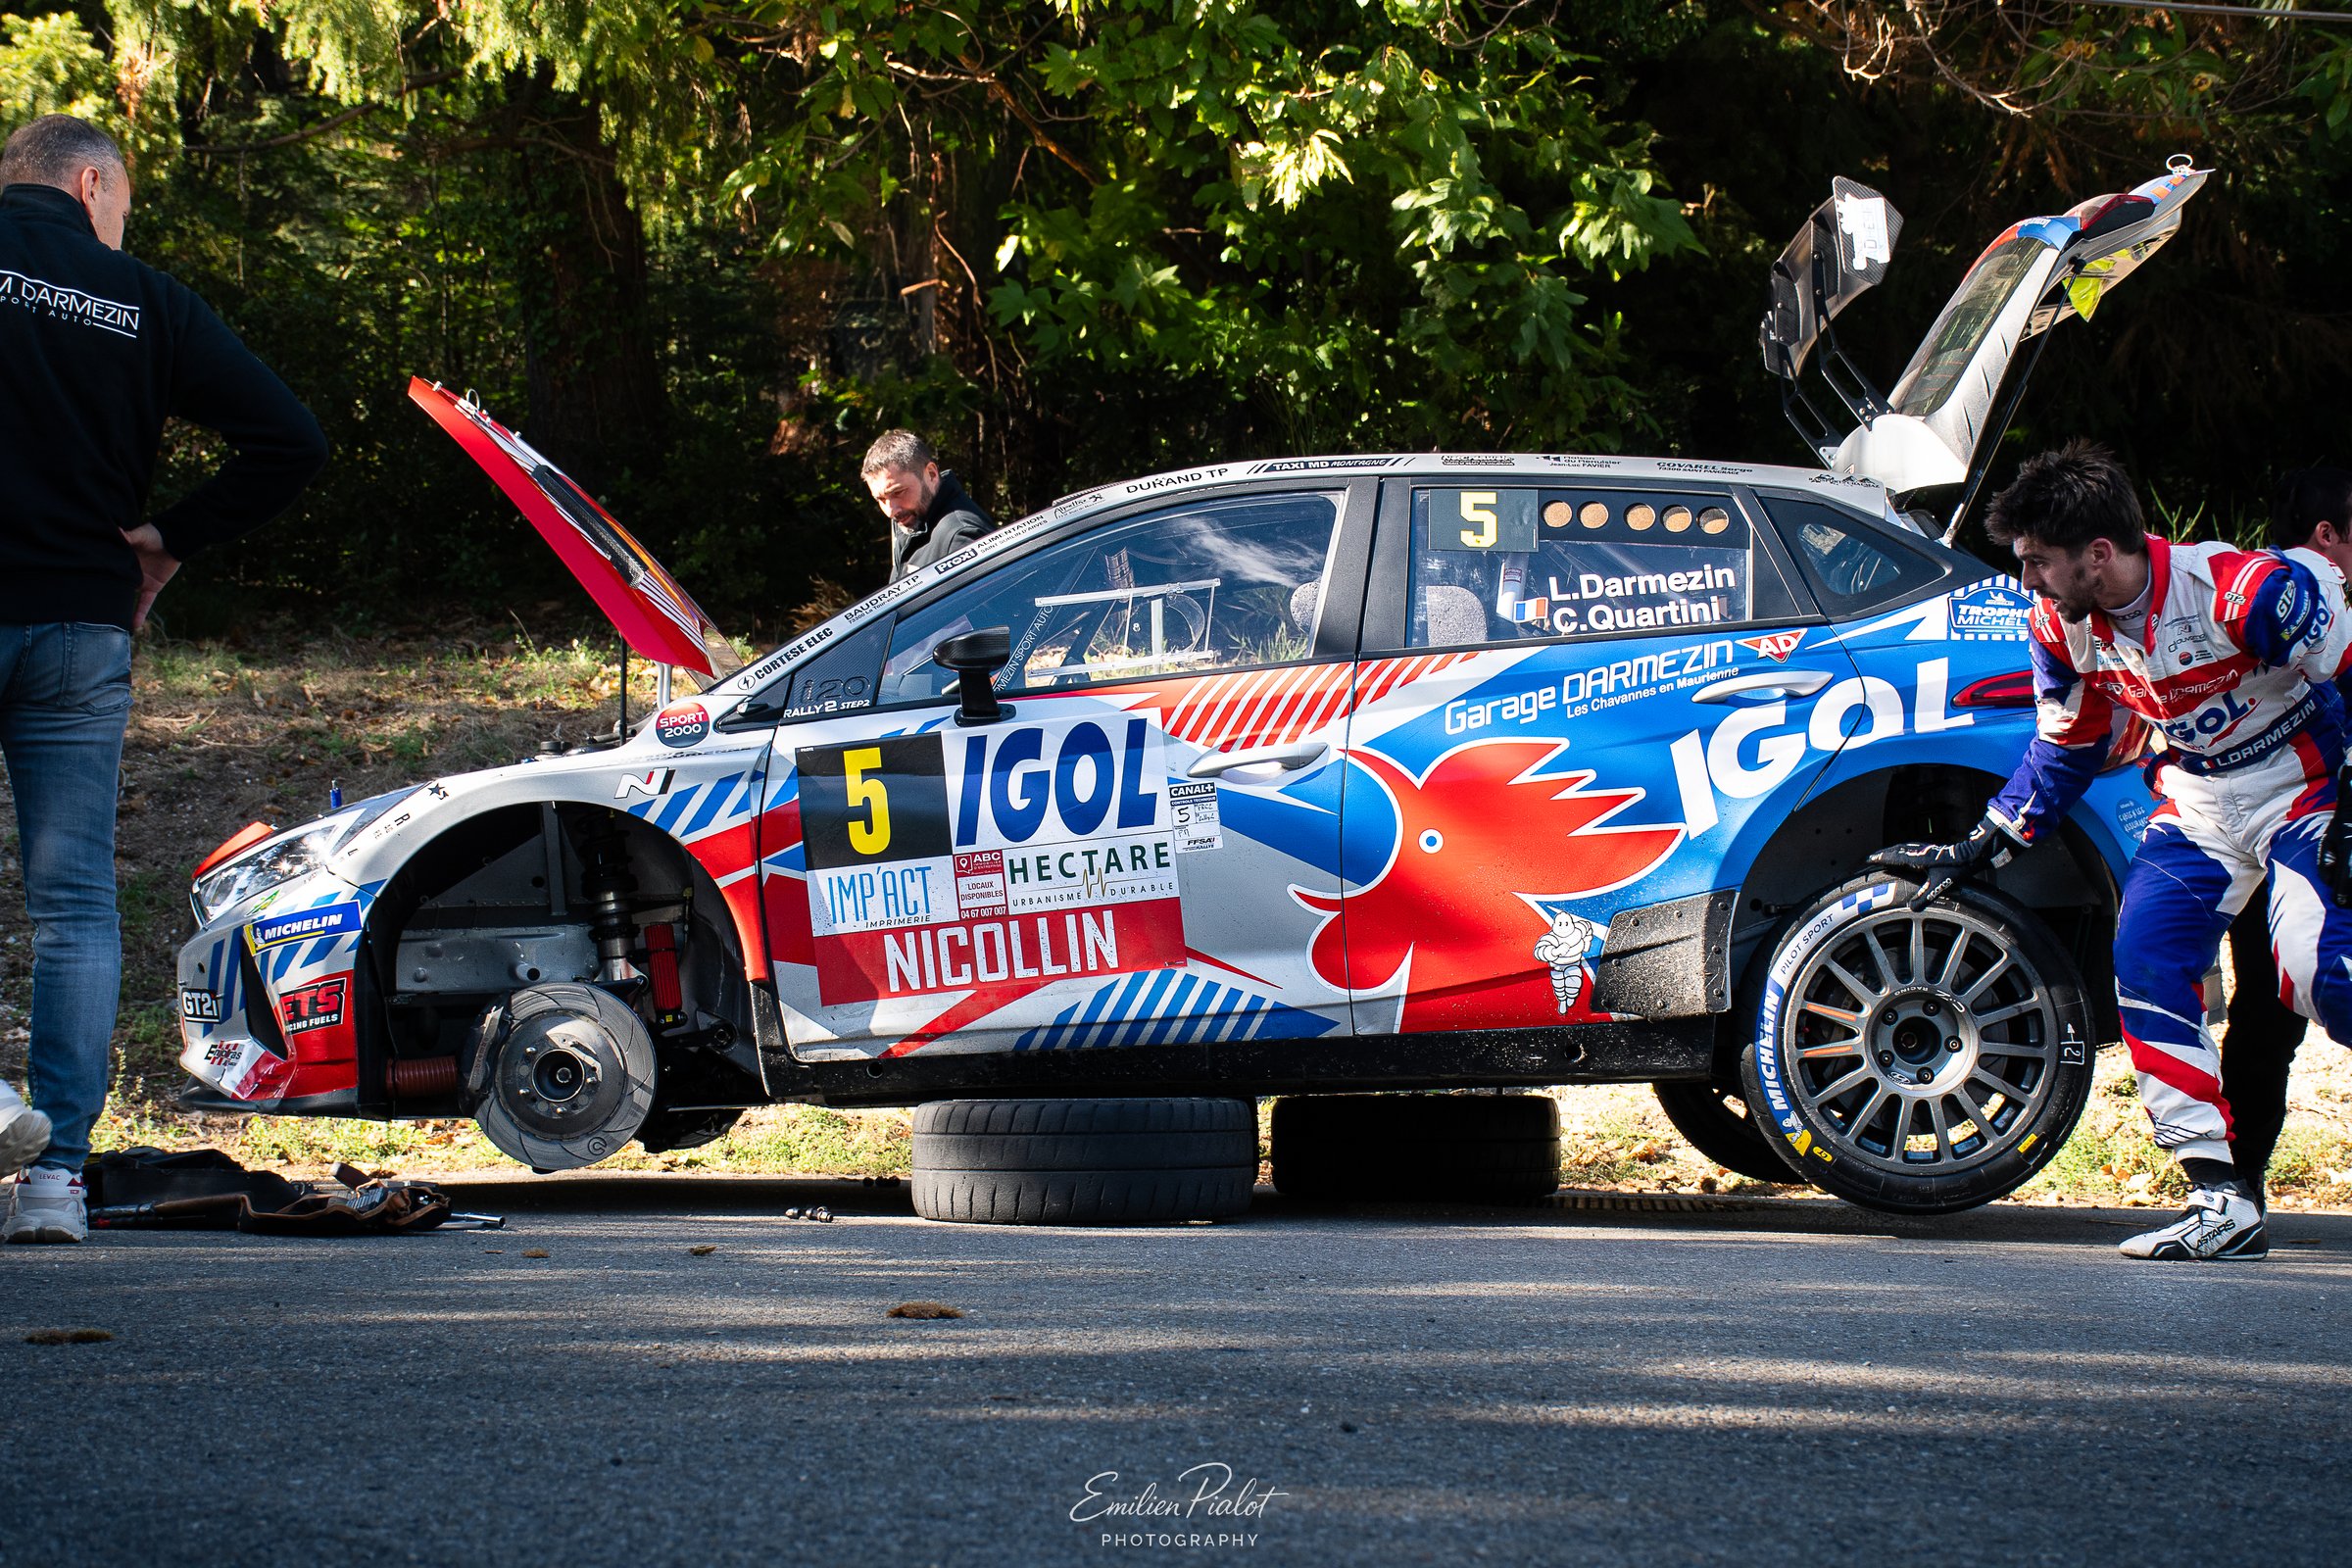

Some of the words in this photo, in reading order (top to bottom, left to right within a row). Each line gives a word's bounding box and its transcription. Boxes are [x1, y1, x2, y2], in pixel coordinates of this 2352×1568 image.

[22, 280, 139, 330] DARMEZIN
[48, 310, 92, 325] AUTO
[1126, 472, 1202, 494] DURAND
[1205, 467, 1229, 478] TP
[1272, 462, 1305, 470] TAXI
[977, 514, 1045, 549] ALIMENTATION
[1459, 491, 1498, 549] 5
[937, 549, 977, 572] Proxi
[844, 585, 902, 621] BAUDRAY
[903, 575, 920, 586] TP
[1548, 563, 1737, 602] L.Darmezin
[1552, 596, 1722, 635] C.Quartini
[1014, 630, 1038, 662] SPORT
[1033, 605, 1054, 631] AUTO
[1757, 634, 1798, 660] AD
[754, 642, 808, 681] CORTESE
[805, 627, 833, 648] ELEC
[1445, 684, 1556, 736] Garage
[1561, 639, 1734, 706] DARMEZIN
[1566, 704, 1589, 719] Les
[1591, 686, 1656, 714] Chavannes
[1659, 682, 1675, 694] en
[1676, 665, 1740, 690] Maurienne
[659, 710, 706, 730] SPORT
[840, 699, 871, 710] STEP2
[663, 722, 702, 738] 2000
[2216, 699, 2317, 768] L.DARMEZIN
[1670, 657, 1975, 841] IGOL
[956, 717, 1158, 848] IGOL
[1170, 783, 1214, 797] CANAL+
[843, 747, 891, 856] 5
[1177, 807, 1191, 823] 5
[973, 852, 1001, 863] ABC
[1008, 841, 1171, 885] HECTARE
[827, 865, 932, 924] IMP'ACT
[960, 889, 1004, 902] DISPONIBLES
[967, 881, 995, 891] LOCAUX
[1012, 892, 1082, 906] URBANISME
[1109, 882, 1174, 897] DURABLE
[265, 912, 343, 941] MICHELIN
[865, 914, 931, 929] IMPRIMERIE
[960, 910, 970, 919] 04
[970, 908, 979, 918] 67
[980, 907, 993, 917] 007
[994, 906, 1006, 915] 007
[883, 909, 1119, 993] NICOLLIN
[1780, 944, 1802, 975] PILOT
[1802, 912, 1835, 945] SPORT
[182, 991, 219, 1016] GT2i
[280, 983, 341, 1022] ETS
[1893, 986, 1930, 997] RACING
[309, 1013, 338, 1027] FUELS
[1759, 988, 1788, 1111] MICHELIN
